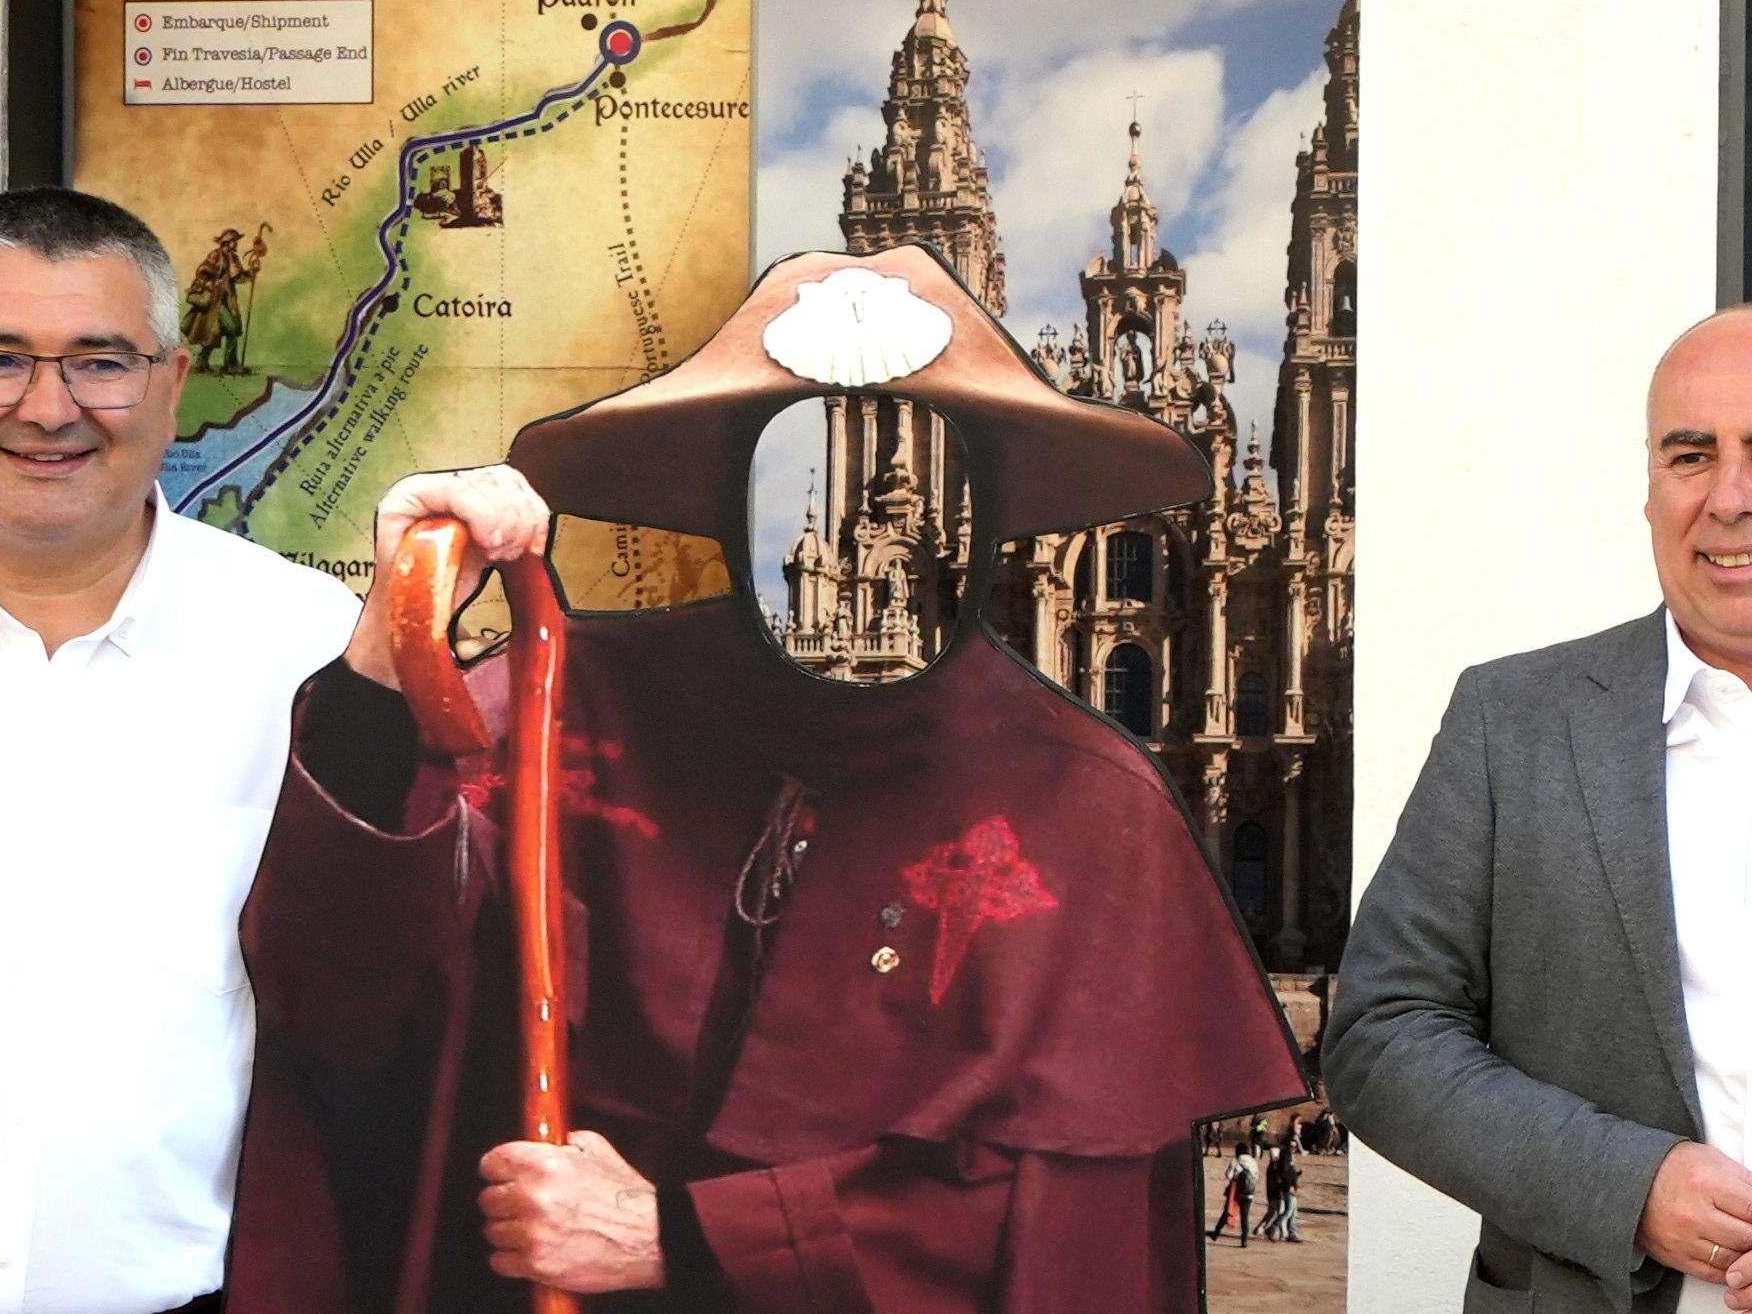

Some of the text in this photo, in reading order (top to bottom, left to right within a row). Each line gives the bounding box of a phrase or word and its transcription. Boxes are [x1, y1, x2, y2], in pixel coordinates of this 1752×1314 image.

[162, 15, 330, 32] Embarque/Shipment
[162, 48, 189, 61] Fin
[336, 45, 368, 60] End
[162, 76, 292, 93] Albergue/Hostel
[348, 138, 385, 170] Ulla
[400, 93, 438, 123] Ulla
[442, 65, 481, 96] river
[608, 243, 634, 288] Trail
[413, 293, 512, 318] Catoira
[299, 460, 331, 497] Ruta
[326, 382, 379, 461] alternativa
[309, 343, 429, 531] Alternative walking route
